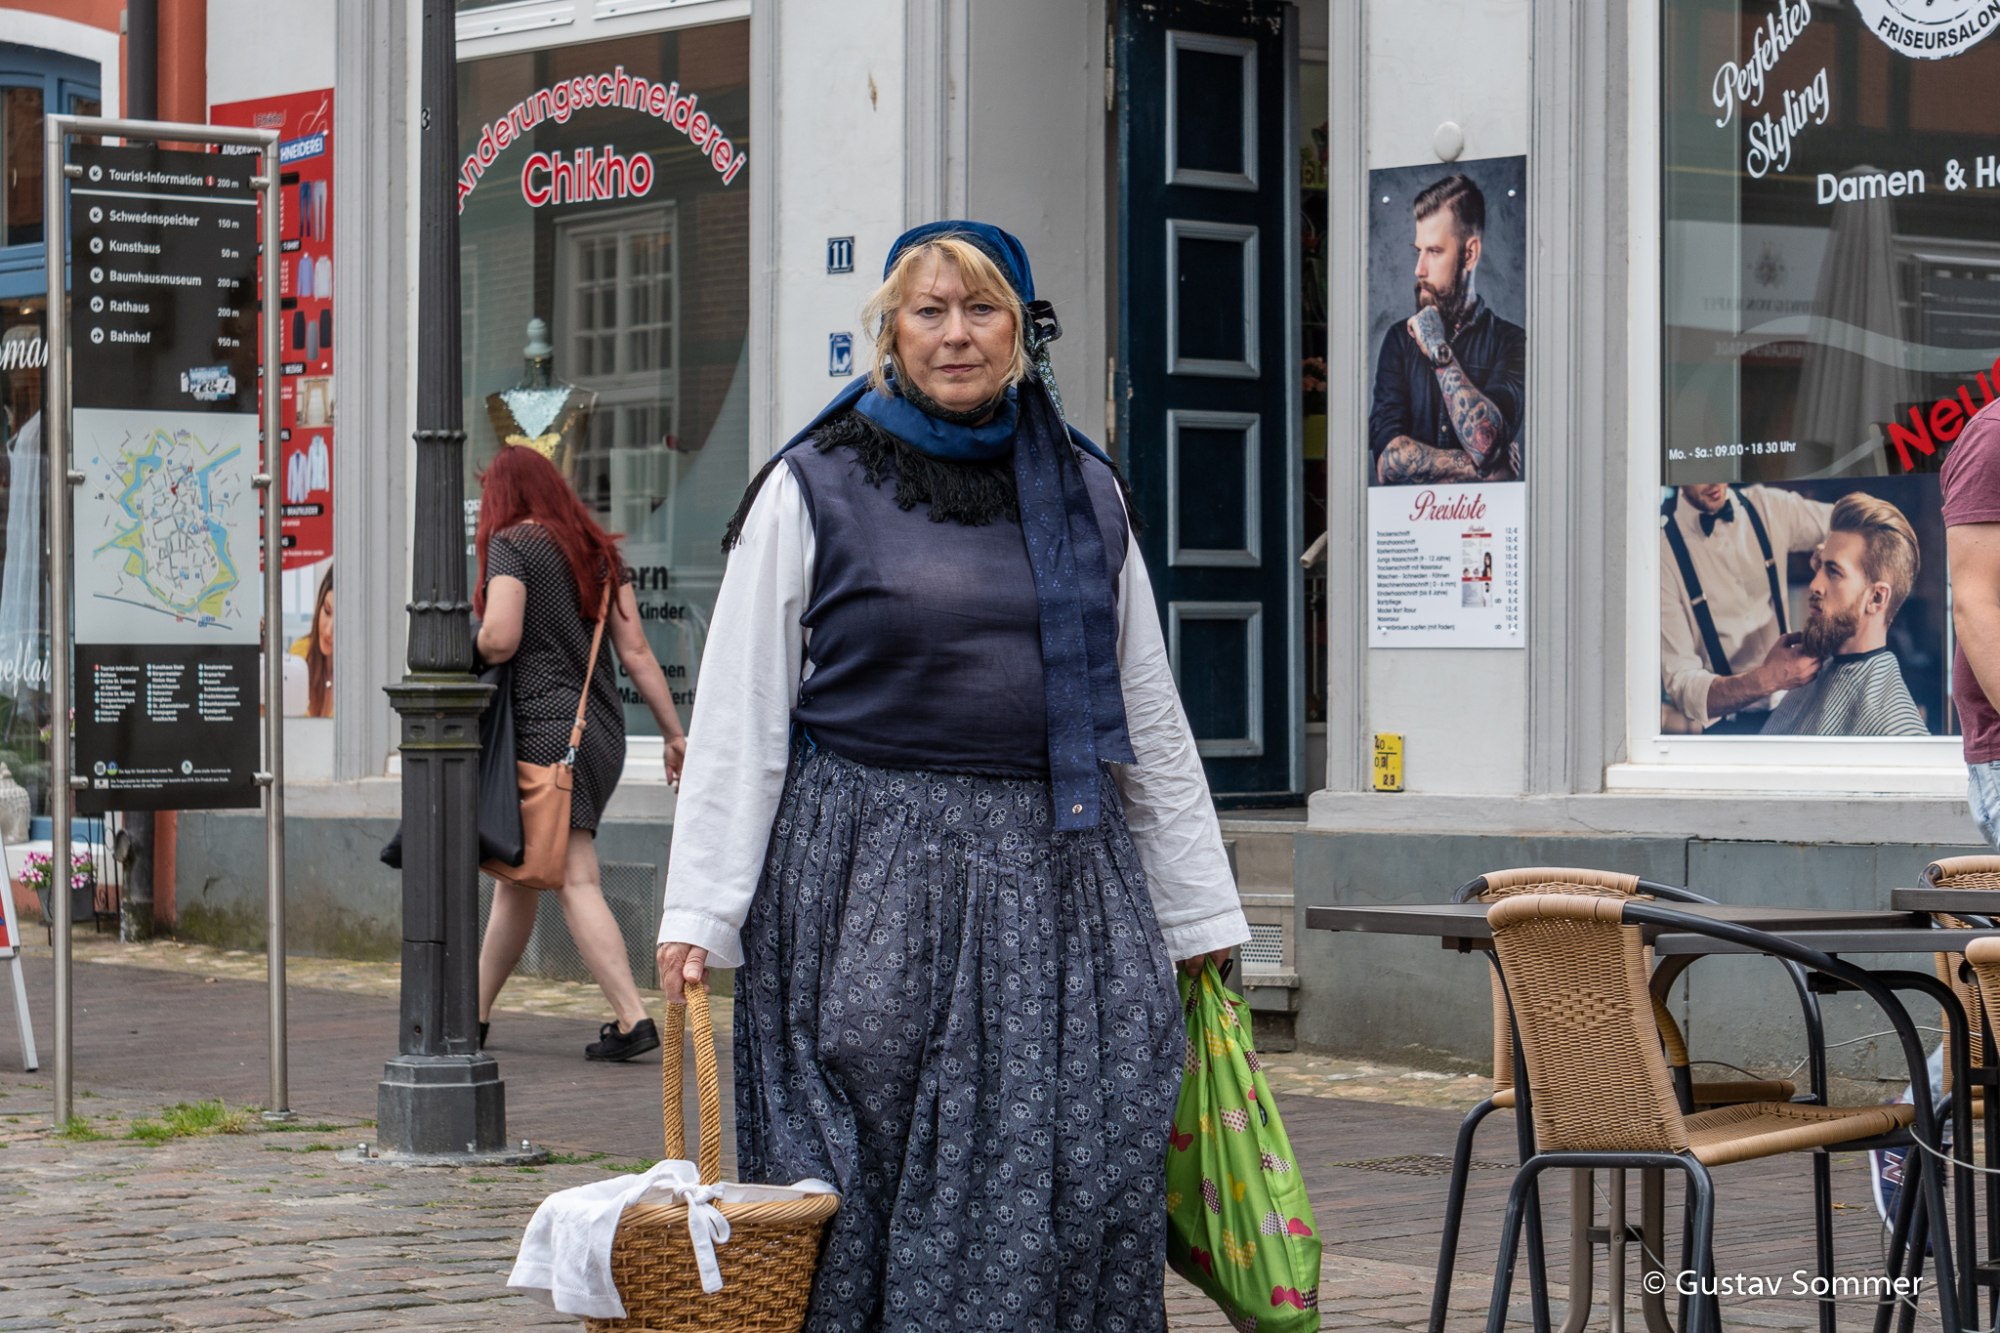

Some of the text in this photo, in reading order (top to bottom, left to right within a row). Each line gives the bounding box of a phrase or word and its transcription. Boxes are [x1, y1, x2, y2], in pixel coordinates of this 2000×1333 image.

[1877, 0, 2000, 50] FRISEURSALON
[1713, 0, 1811, 128] Perfektes
[1747, 66, 1830, 179] Styling
[109, 169, 239, 188] Tourist-Information 200 m
[521, 145, 654, 207] Chikho
[1817, 168, 1925, 205] Damen
[1944, 158, 1968, 191] &
[109, 210, 240, 229] Schwedenspeicher 150 m
[109, 240, 161, 254] Kunsthaus
[221, 249, 230, 258] 50
[831, 241, 849, 269] 11
[109, 270, 239, 288] Baumhausmuseum 200 m
[109, 300, 239, 318] Rathaus 200 m
[109, 330, 151, 343] Bahnhof
[217, 338, 230, 347] 950
[1669, 448, 1687, 460] Mo.
[1694, 447, 1713, 459] Sa.:
[1714, 443, 1744, 457] 09.00
[1780, 440, 1796, 453] Uhr
[1409, 489, 1487, 522] Preisliste
